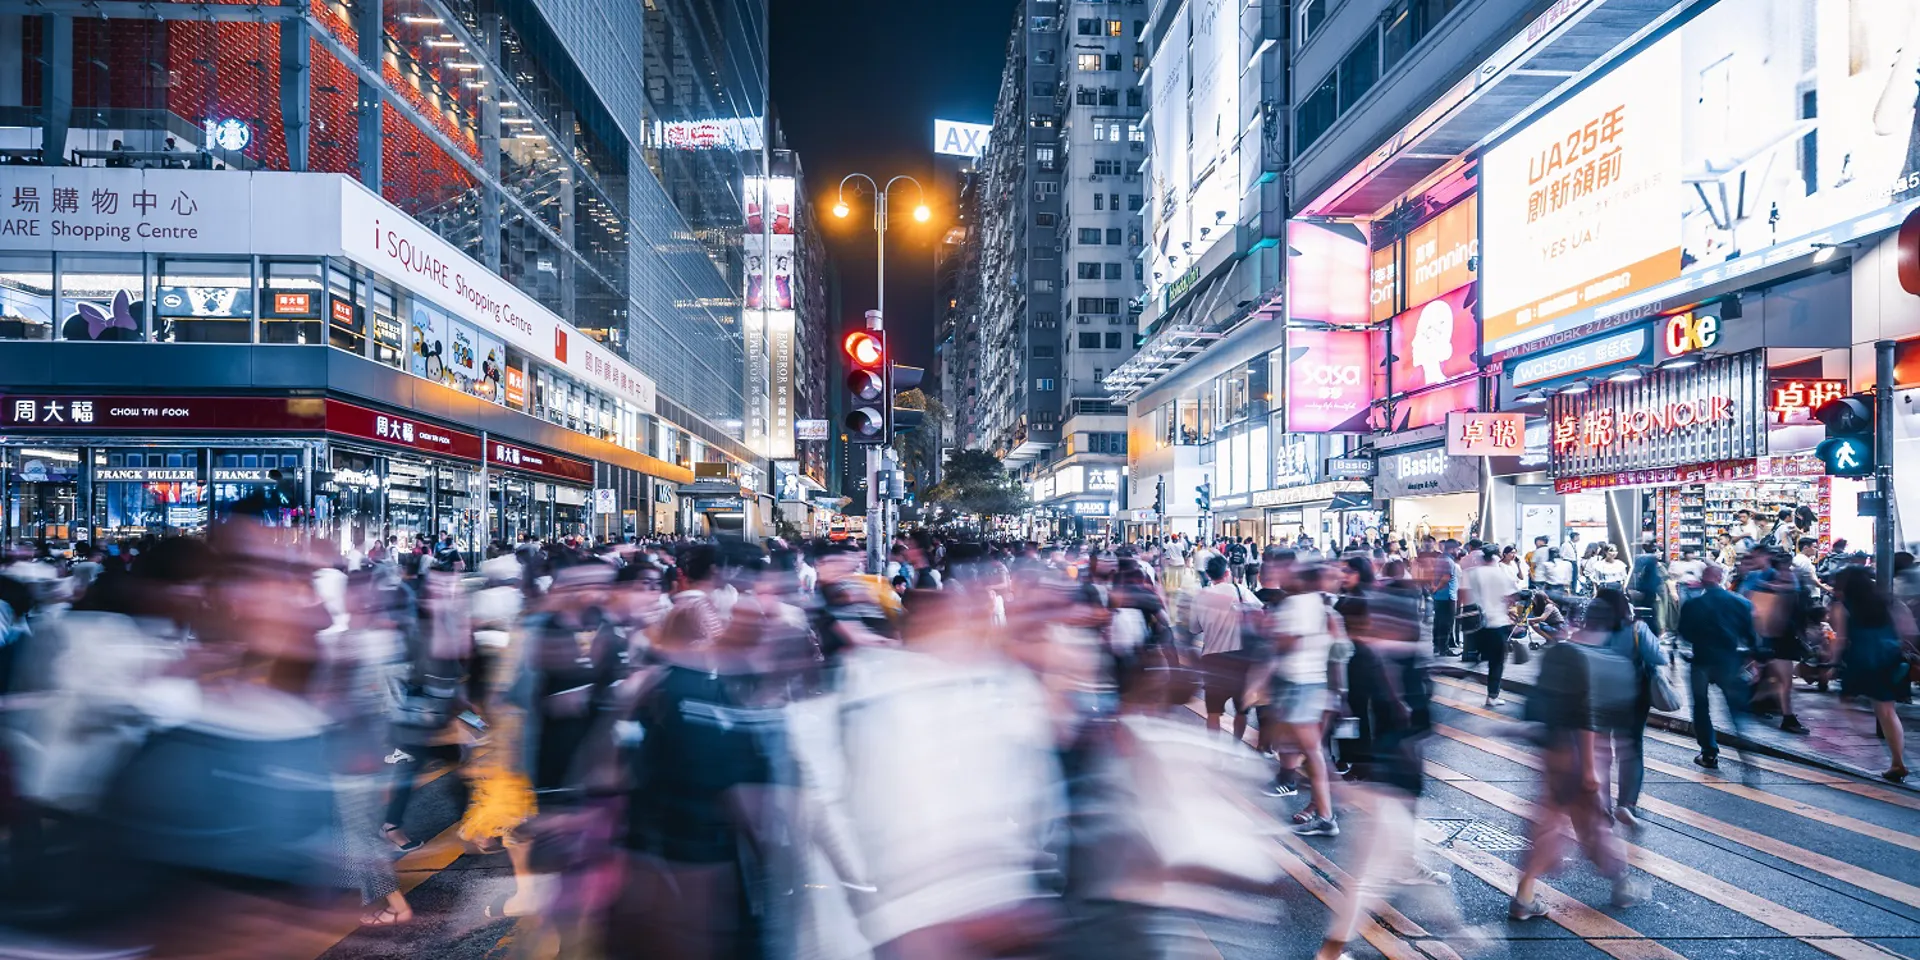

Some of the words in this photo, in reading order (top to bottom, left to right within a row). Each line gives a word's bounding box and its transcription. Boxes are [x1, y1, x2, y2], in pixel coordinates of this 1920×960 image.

[0, 186, 199, 217] 場購物中心
[51, 221, 130, 241] Shopping
[137, 222, 198, 239] Centre
[375, 220, 380, 249] i
[387, 231, 449, 289] SQUARE
[455, 274, 501, 323] Shopping
[503, 304, 532, 335] Centre
[1522, 328, 1581, 355] NETWORK
[1586, 301, 1662, 334] 27230020
[1520, 351, 1586, 379] watsons
[14, 400, 94, 423] 周大福
[110, 407, 139, 416] CHOW
[141, 408, 158, 416] TAI
[161, 408, 189, 417] FOOK
[1619, 395, 1734, 434] BONJOUR
[376, 415, 413, 442] 周大福
[496, 445, 520, 465] 周大福
[97, 469, 142, 479] FRANCK
[147, 469, 195, 479] MULLER
[215, 470, 260, 480] FRANCK
